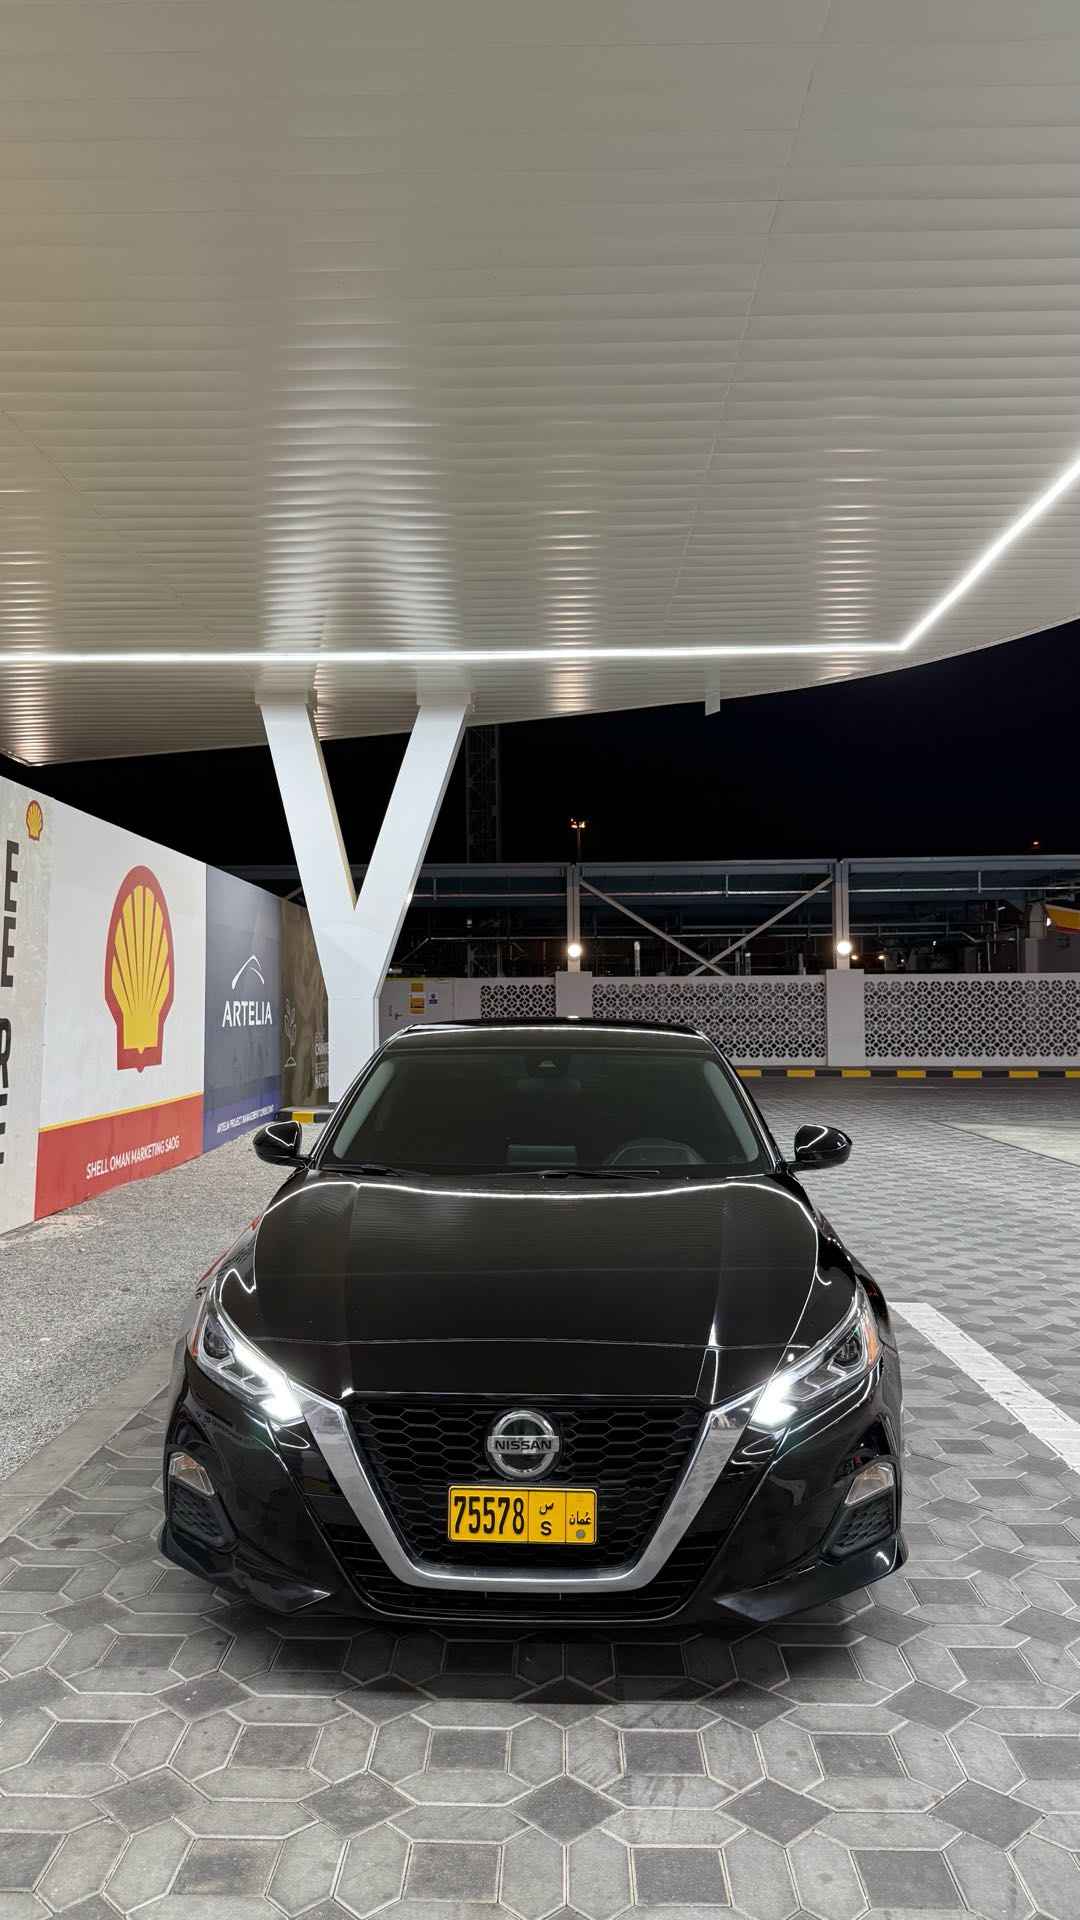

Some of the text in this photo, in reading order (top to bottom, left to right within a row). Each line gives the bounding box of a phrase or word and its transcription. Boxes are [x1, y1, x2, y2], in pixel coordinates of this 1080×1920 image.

[221, 1000, 273, 1028] ARTELIA
[86, 1135, 180, 1179] SHELL OMAN MARKETING SAOG
[494, 1440, 552, 1451] NISSAN
[453, 1495, 526, 1535] 75578
[539, 1502, 554, 1515] س
[540, 1520, 553, 1536] S
